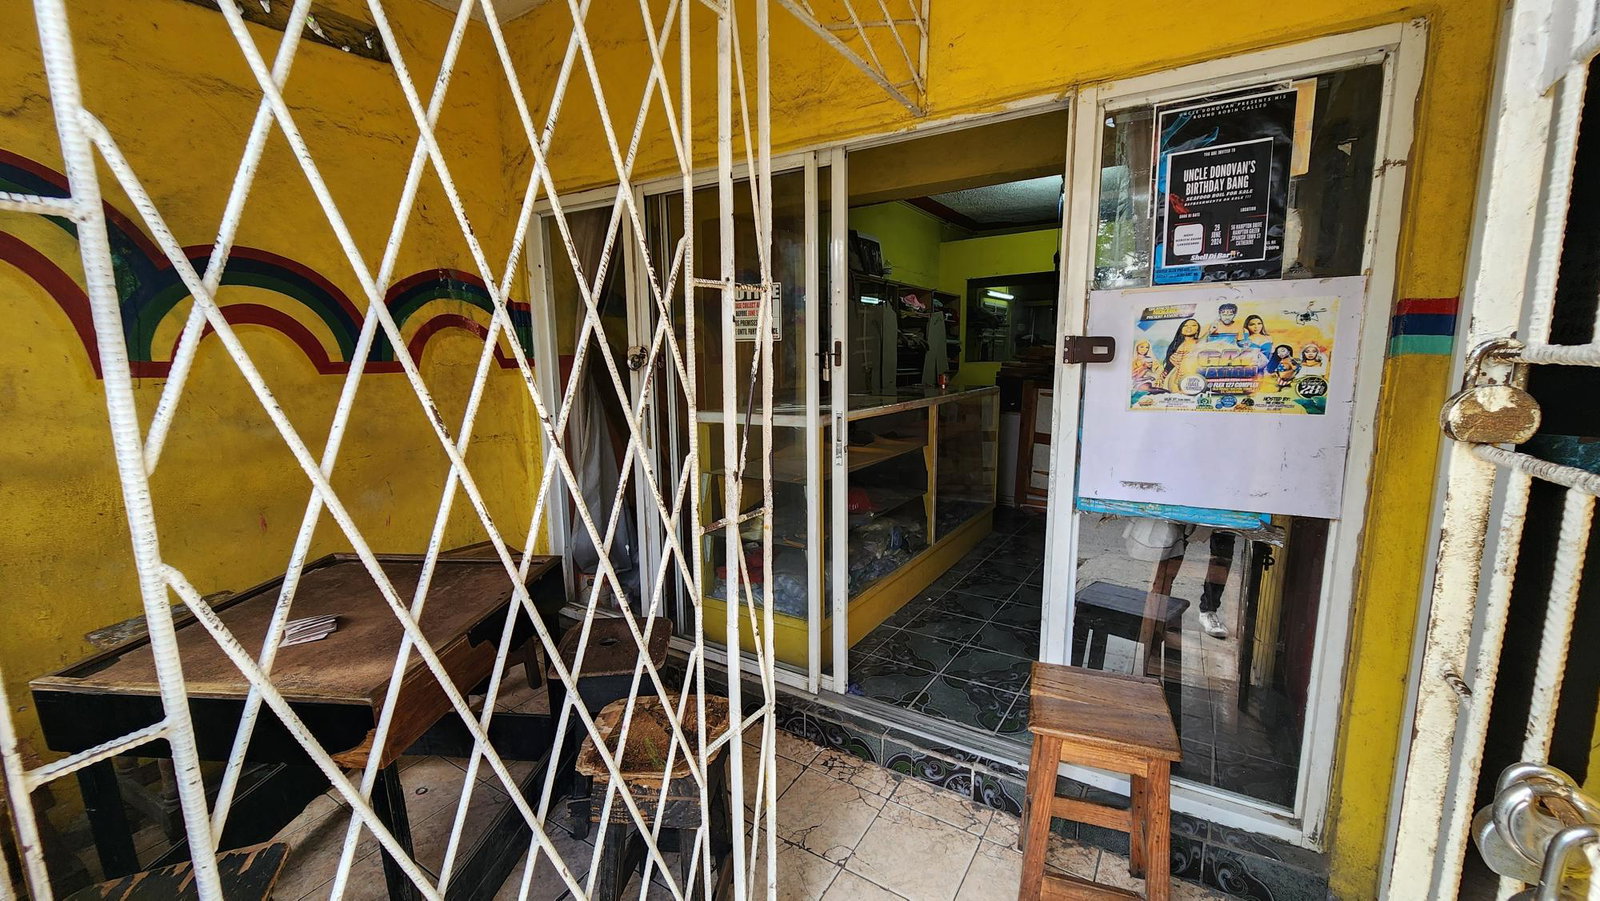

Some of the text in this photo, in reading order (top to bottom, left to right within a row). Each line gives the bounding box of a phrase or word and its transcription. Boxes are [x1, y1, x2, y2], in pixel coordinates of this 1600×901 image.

[1202, 104, 1234, 113] DONOVAN
[1238, 98, 1271, 107] PRESENTS
[1183, 160, 1256, 182] UNCLE DONOVAN'S
[1185, 175, 1250, 196] BIRTHDAY BANG
[1211, 231, 1222, 239] JUNE
[1191, 253, 1208, 261] Shell
